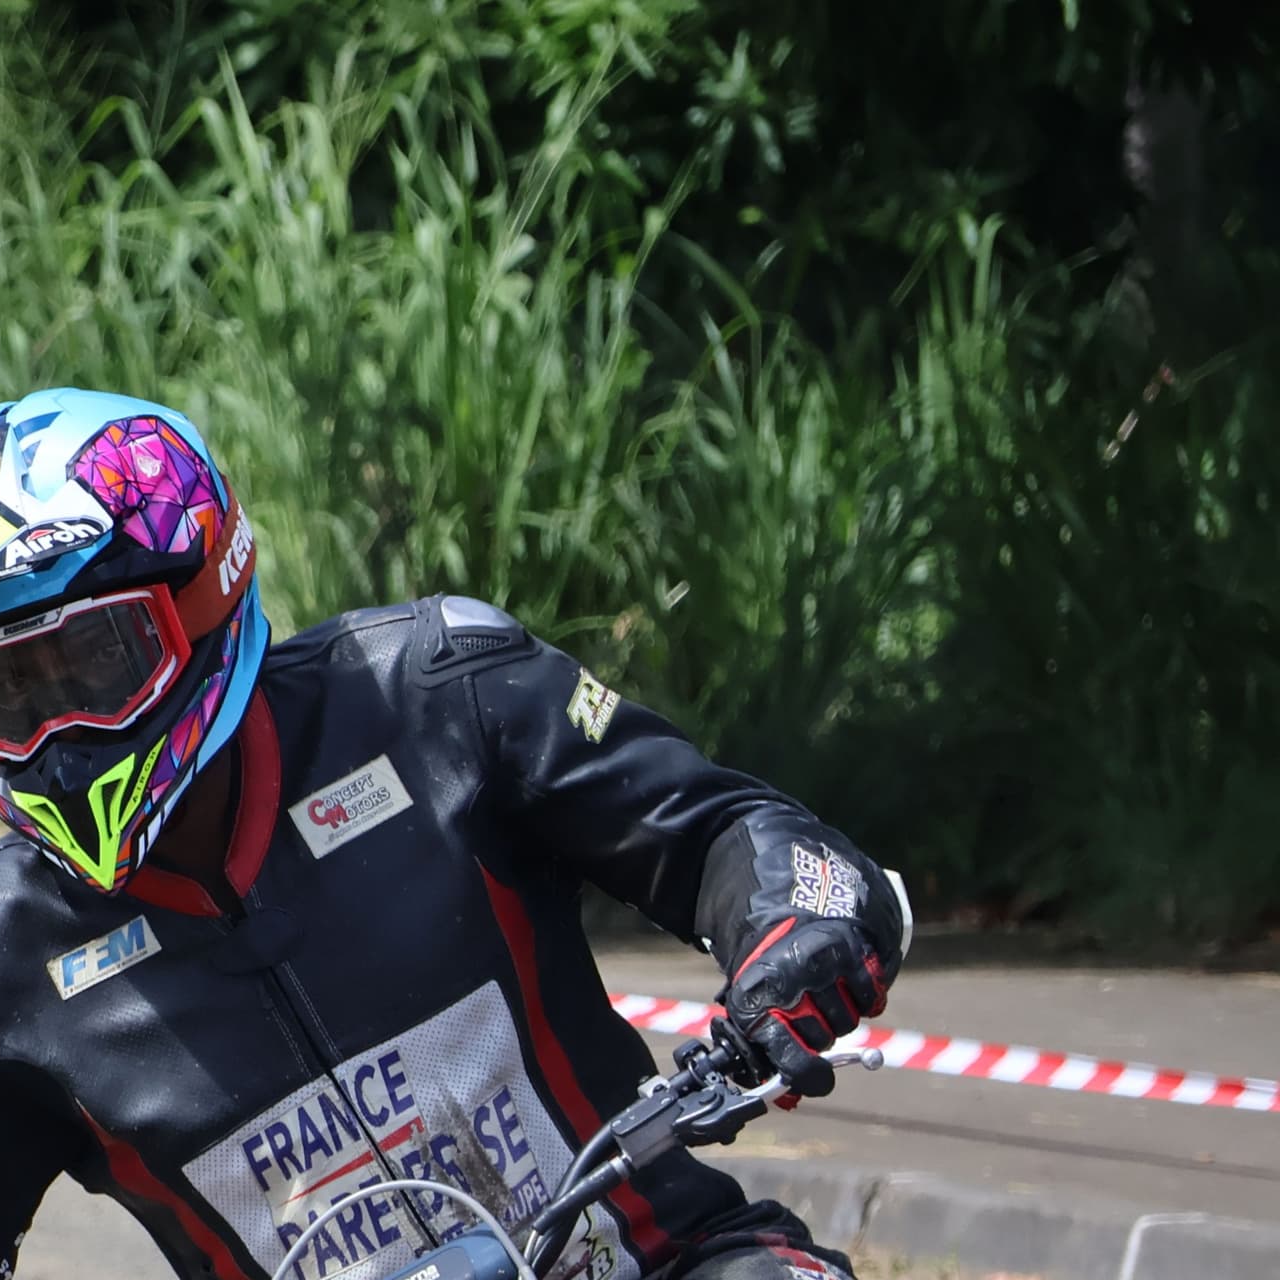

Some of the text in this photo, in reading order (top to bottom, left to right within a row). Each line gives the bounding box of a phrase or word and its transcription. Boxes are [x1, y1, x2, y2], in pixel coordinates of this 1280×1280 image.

[4, 521, 100, 568] Airoh
[307, 773, 375, 827] CONCEPT
[324, 786, 392, 830] MOTORS
[242, 1049, 416, 1192] FRANCE
